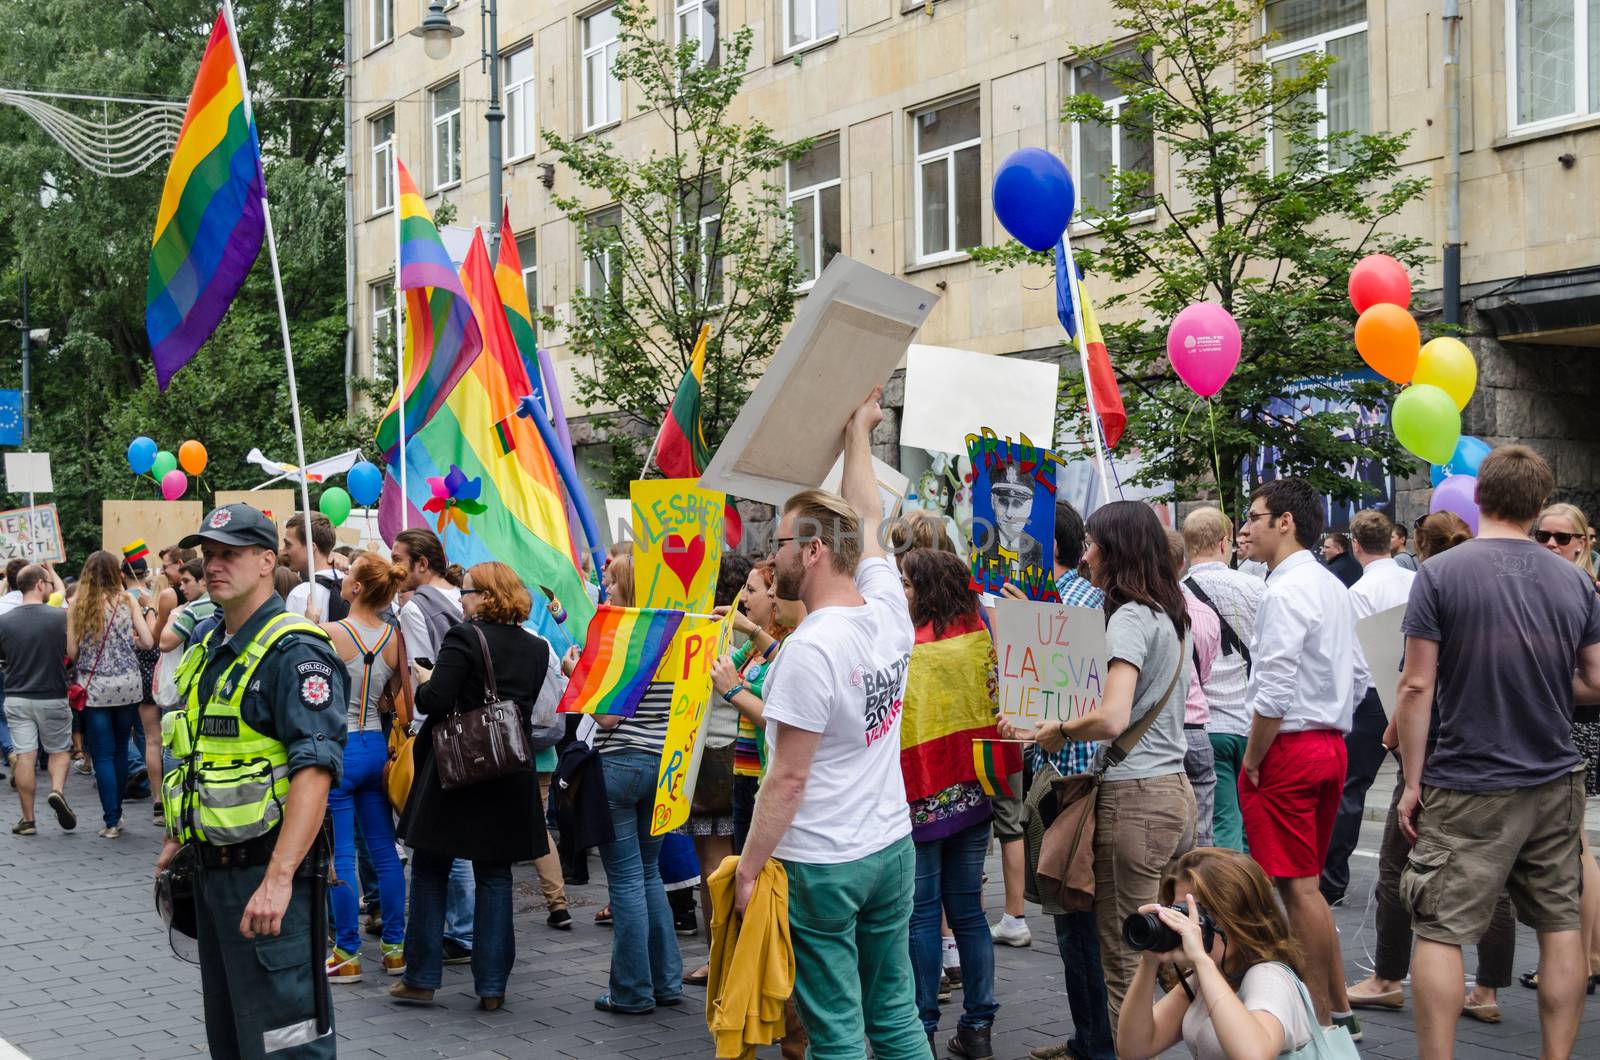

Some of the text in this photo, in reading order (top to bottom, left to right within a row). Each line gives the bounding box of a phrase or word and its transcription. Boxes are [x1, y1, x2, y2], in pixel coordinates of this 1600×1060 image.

[964, 426, 1068, 496] PRIDE
[1036, 610, 1071, 647] UŽ
[299, 661, 330, 674] POLICIJA
